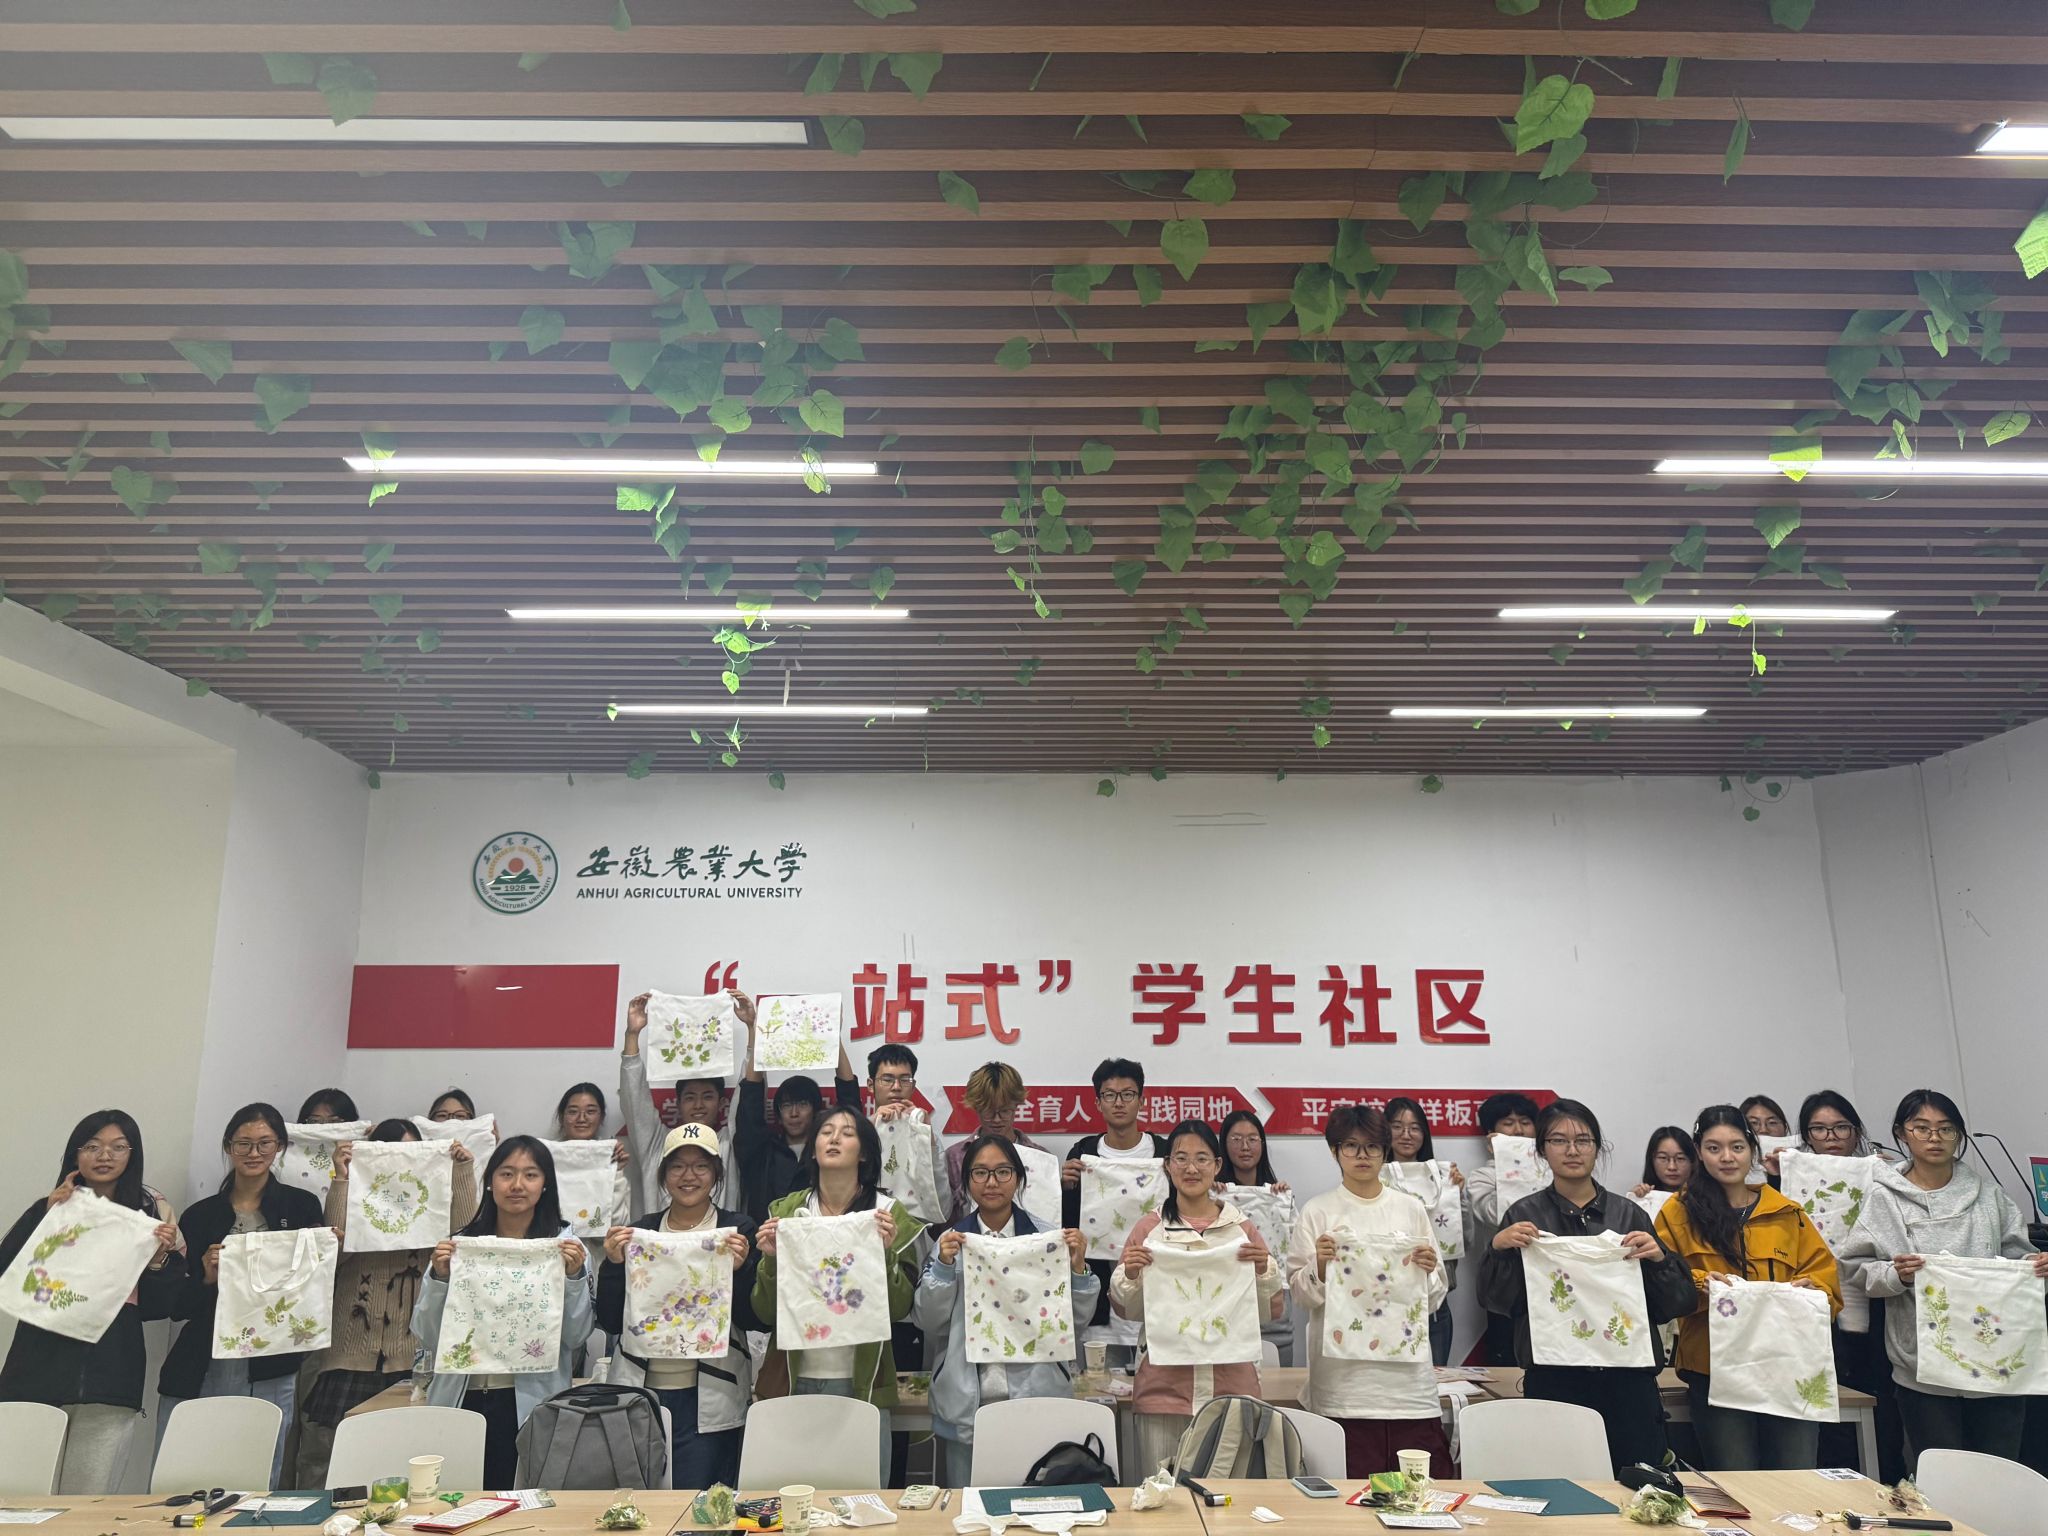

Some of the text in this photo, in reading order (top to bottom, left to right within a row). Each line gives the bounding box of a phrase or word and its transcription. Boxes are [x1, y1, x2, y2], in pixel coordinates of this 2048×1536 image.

[504, 884, 526, 892] 1928
[576, 887, 803, 899] ANHUI AGRICULTURAL UNIVERSITY
[703, 960, 1491, 1047] “站式”学生社区
